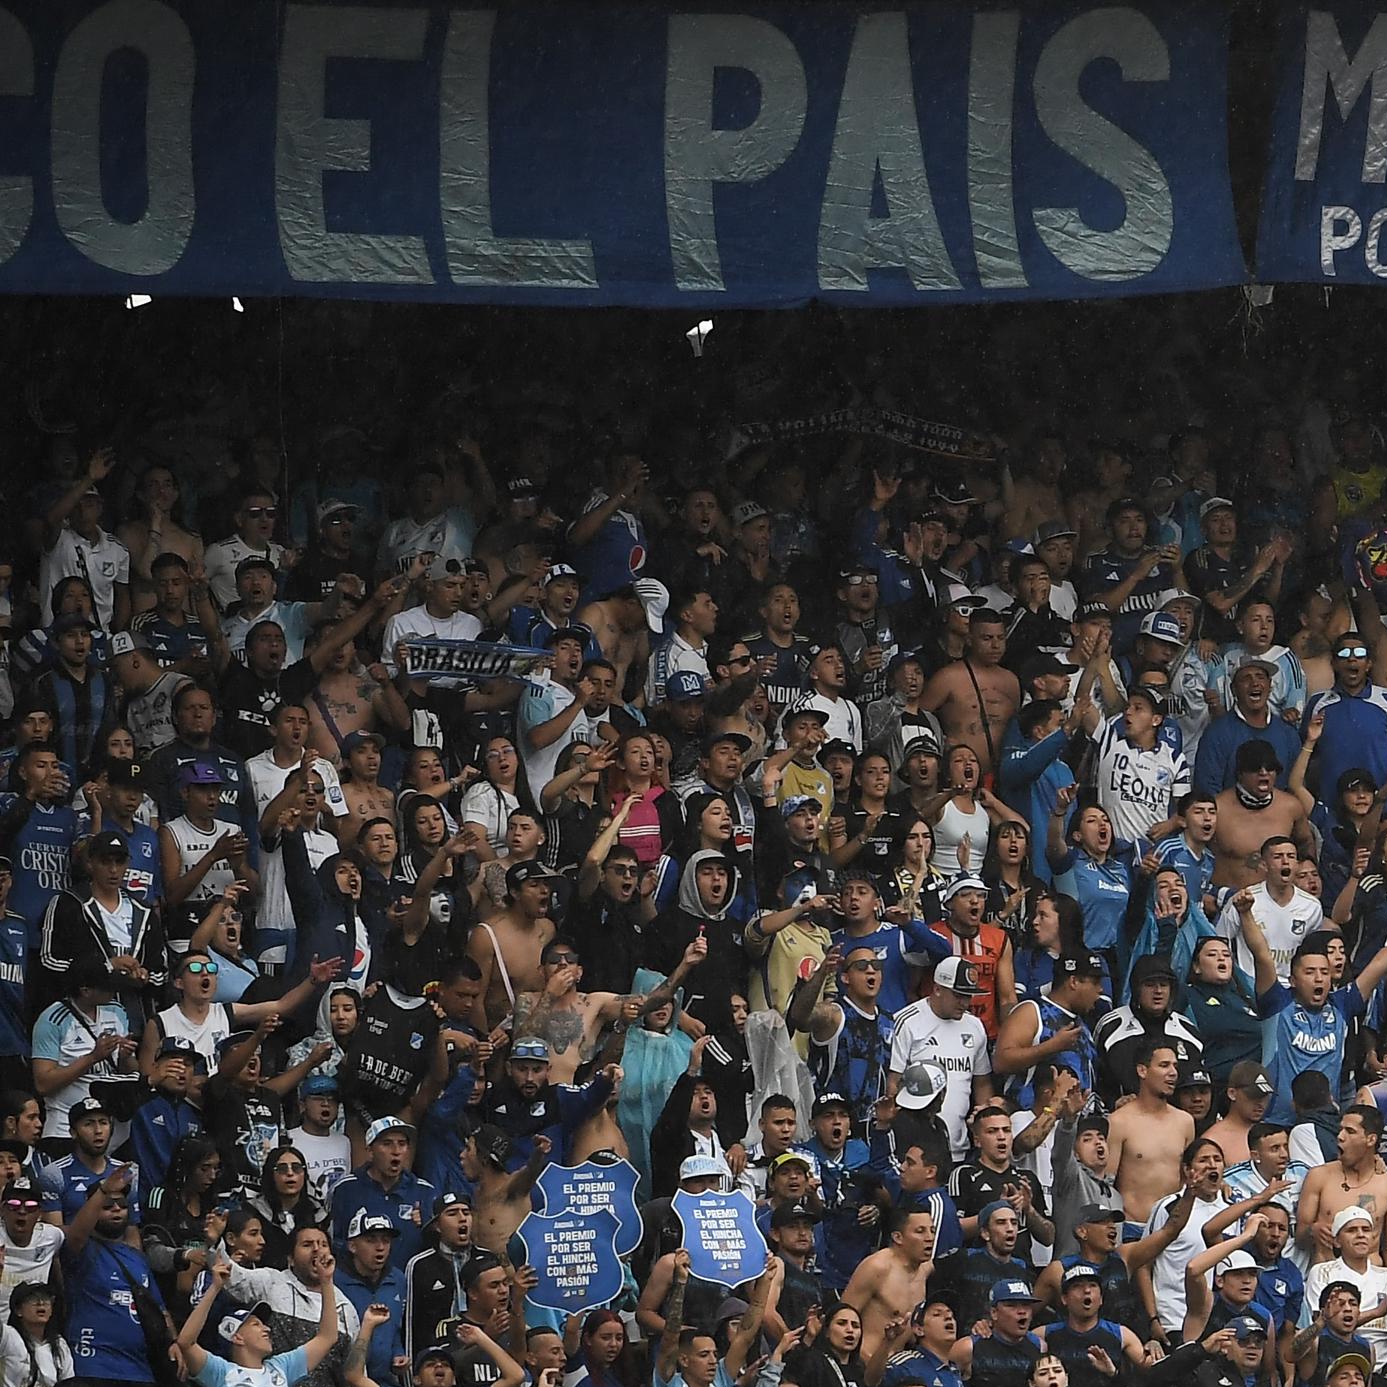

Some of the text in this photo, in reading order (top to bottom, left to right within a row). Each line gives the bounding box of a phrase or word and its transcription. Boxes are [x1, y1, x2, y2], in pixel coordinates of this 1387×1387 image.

[0, 0, 1173, 293] O EL PAIS
[0, 962, 24, 985] DINA
[1291, 1031, 1337, 1052] ANDINA
[563, 1181, 616, 1194] EL PREMIO
[570, 1194, 610, 1205] POR SER
[694, 1208, 738, 1219] EL PREMIO
[701, 1219, 736, 1229] POR SER
[544, 1230, 596, 1243] EL PREMIO
[700, 1229, 742, 1240] EL HINCHA
[551, 1242, 592, 1254] POR SER
[702, 1239, 747, 1250] CON MÁS
[547, 1253, 597, 1265] EL HINCHA
[713, 1250, 741, 1261] PASIÓN
[546, 1263, 598, 1277] CON MÁS
[556, 1275, 590, 1287] PASIÓN
